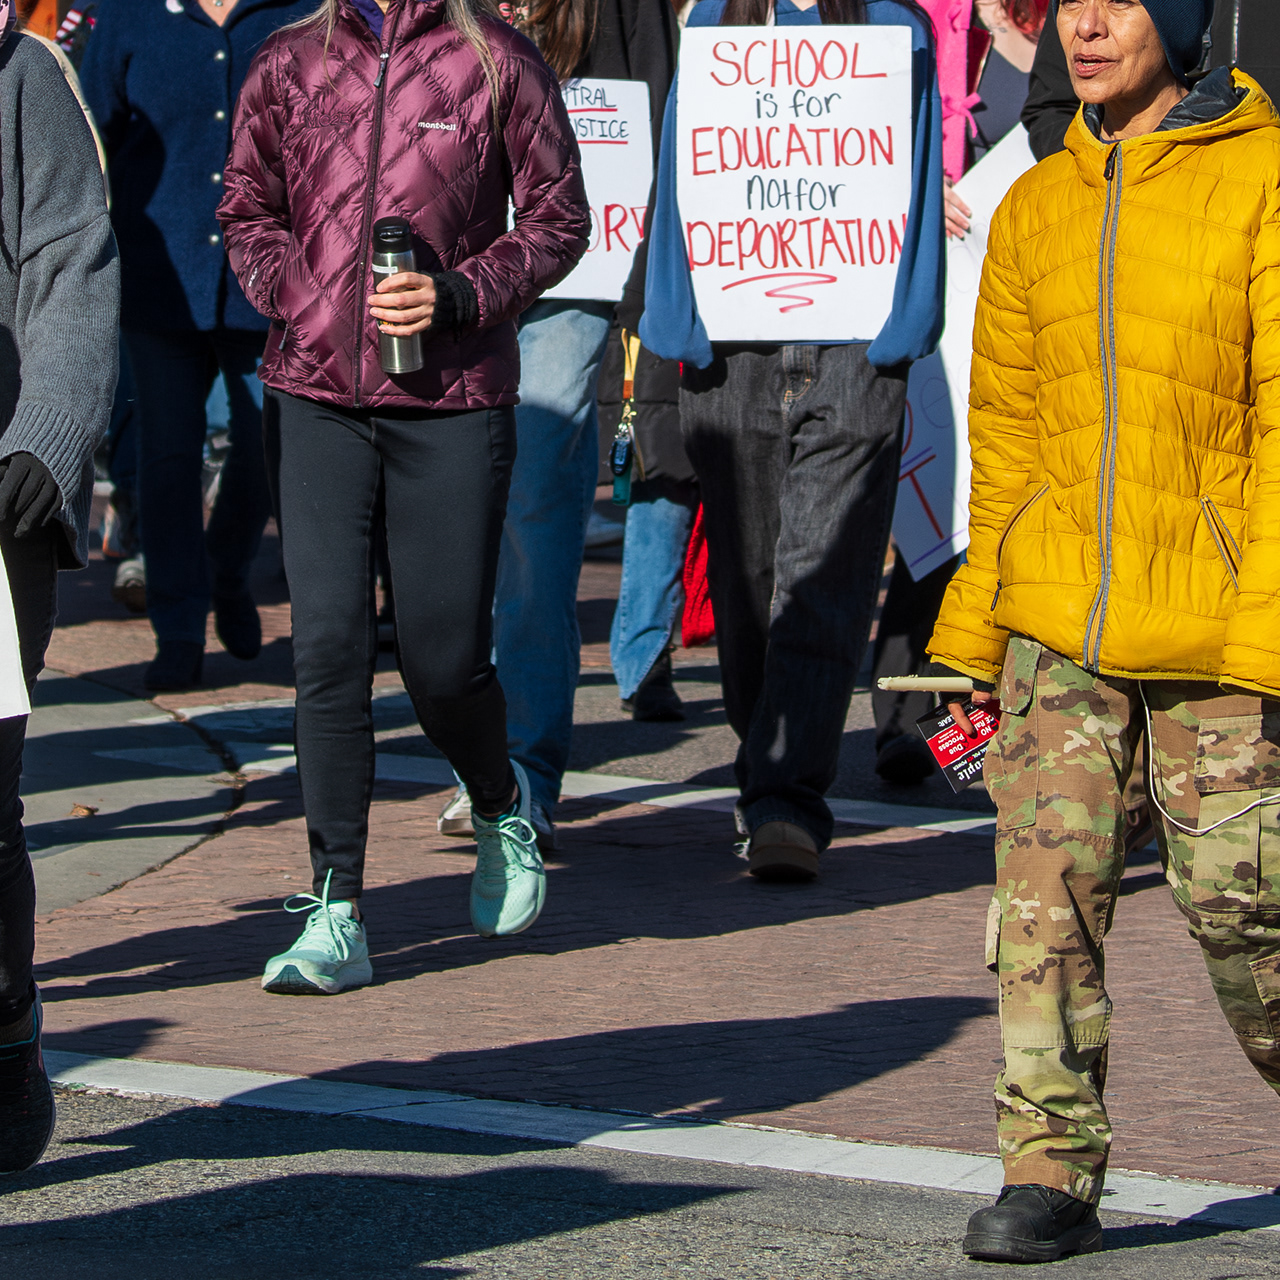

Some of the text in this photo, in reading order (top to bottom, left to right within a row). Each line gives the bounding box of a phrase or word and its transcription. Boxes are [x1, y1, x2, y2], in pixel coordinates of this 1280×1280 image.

[709, 38, 888, 88] SCHOOL
[755, 89, 842, 120] is for
[691, 124, 895, 176] EDUCATION
[686, 213, 907, 272] DEPORTATION
[938, 733, 965, 753] Process
[980, 724, 992, 736] NO
[949, 743, 965, 756] Due
